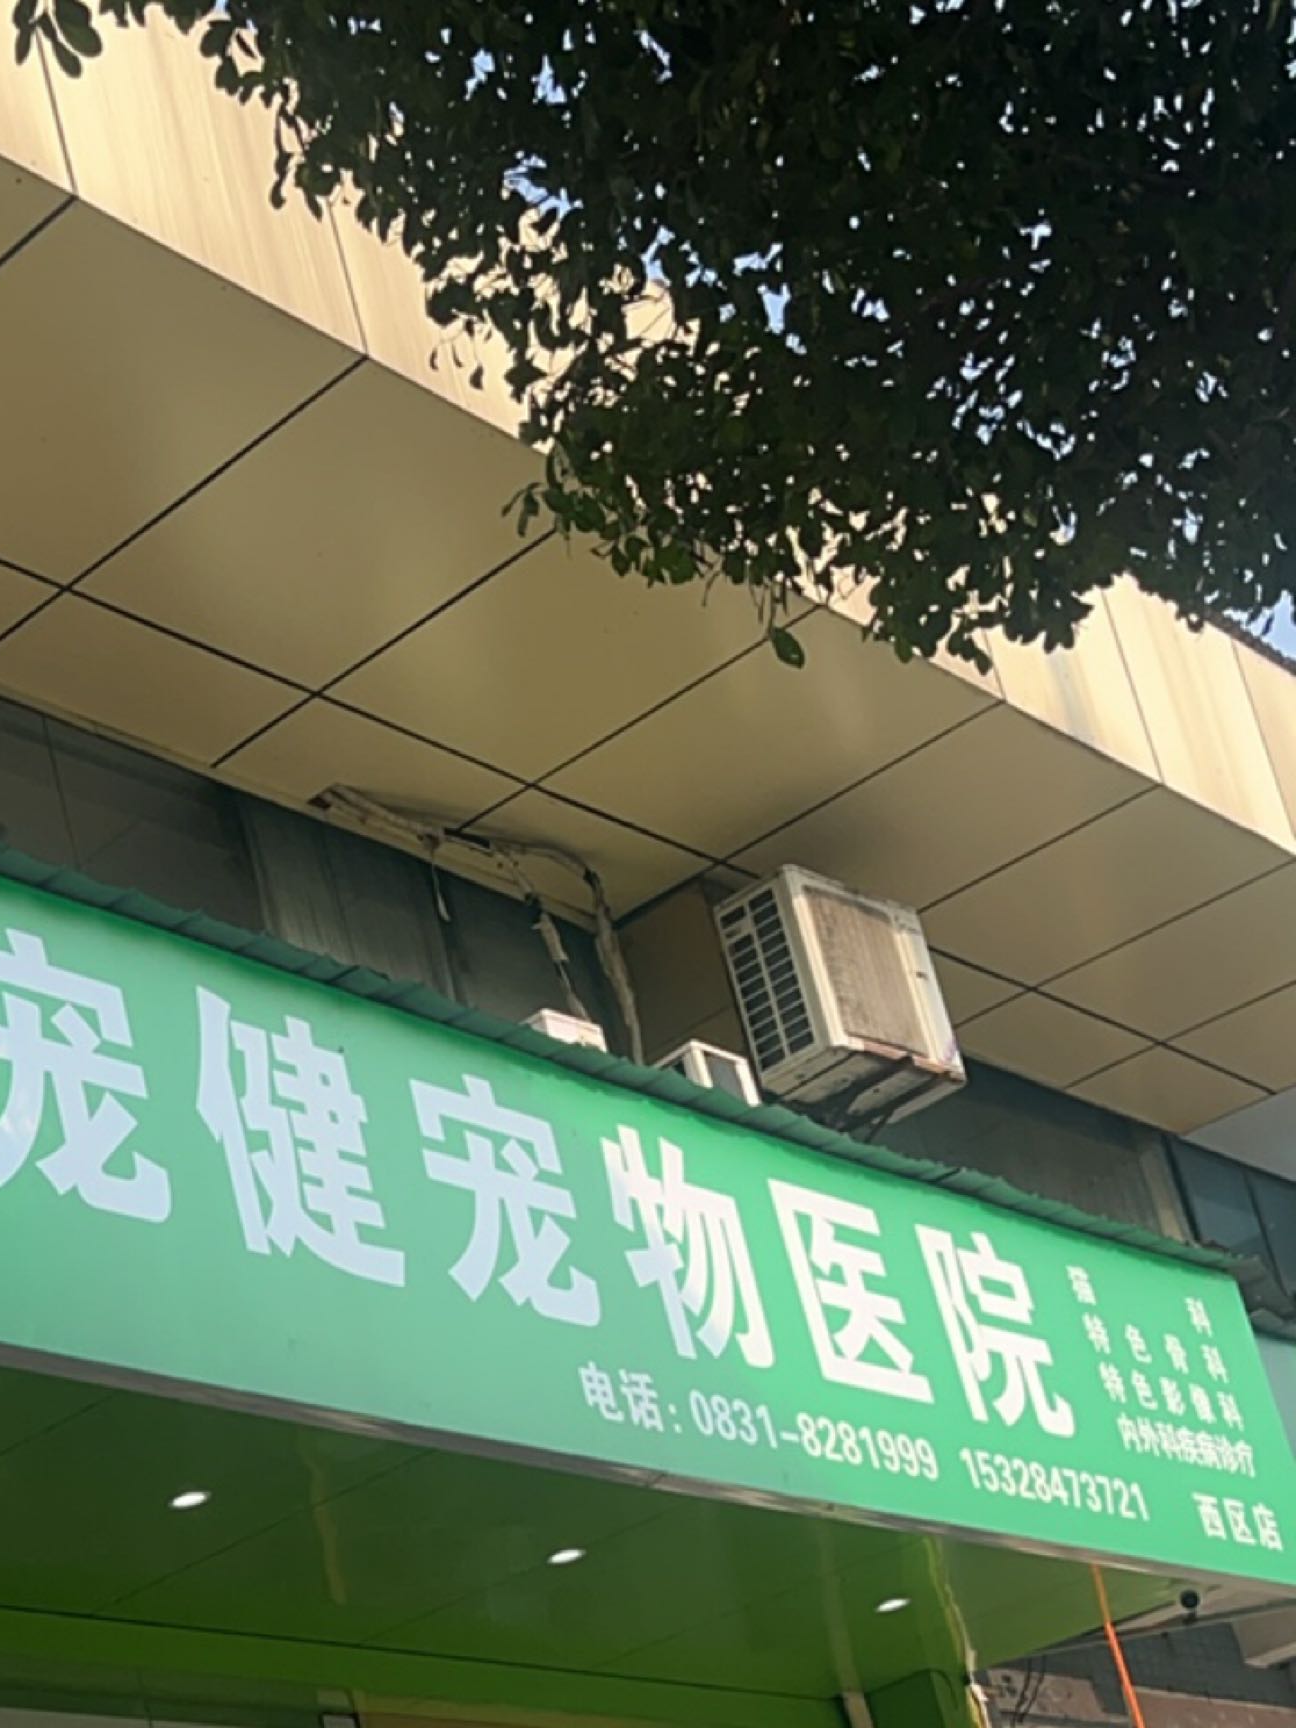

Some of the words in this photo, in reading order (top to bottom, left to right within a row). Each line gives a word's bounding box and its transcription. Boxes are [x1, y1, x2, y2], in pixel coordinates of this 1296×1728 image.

[1081, 1312, 1230, 1384] 特色骨科
[959, 1446, 1151, 1521] 15328473721
[1191, 1491, 1284, 1552] 西区店
